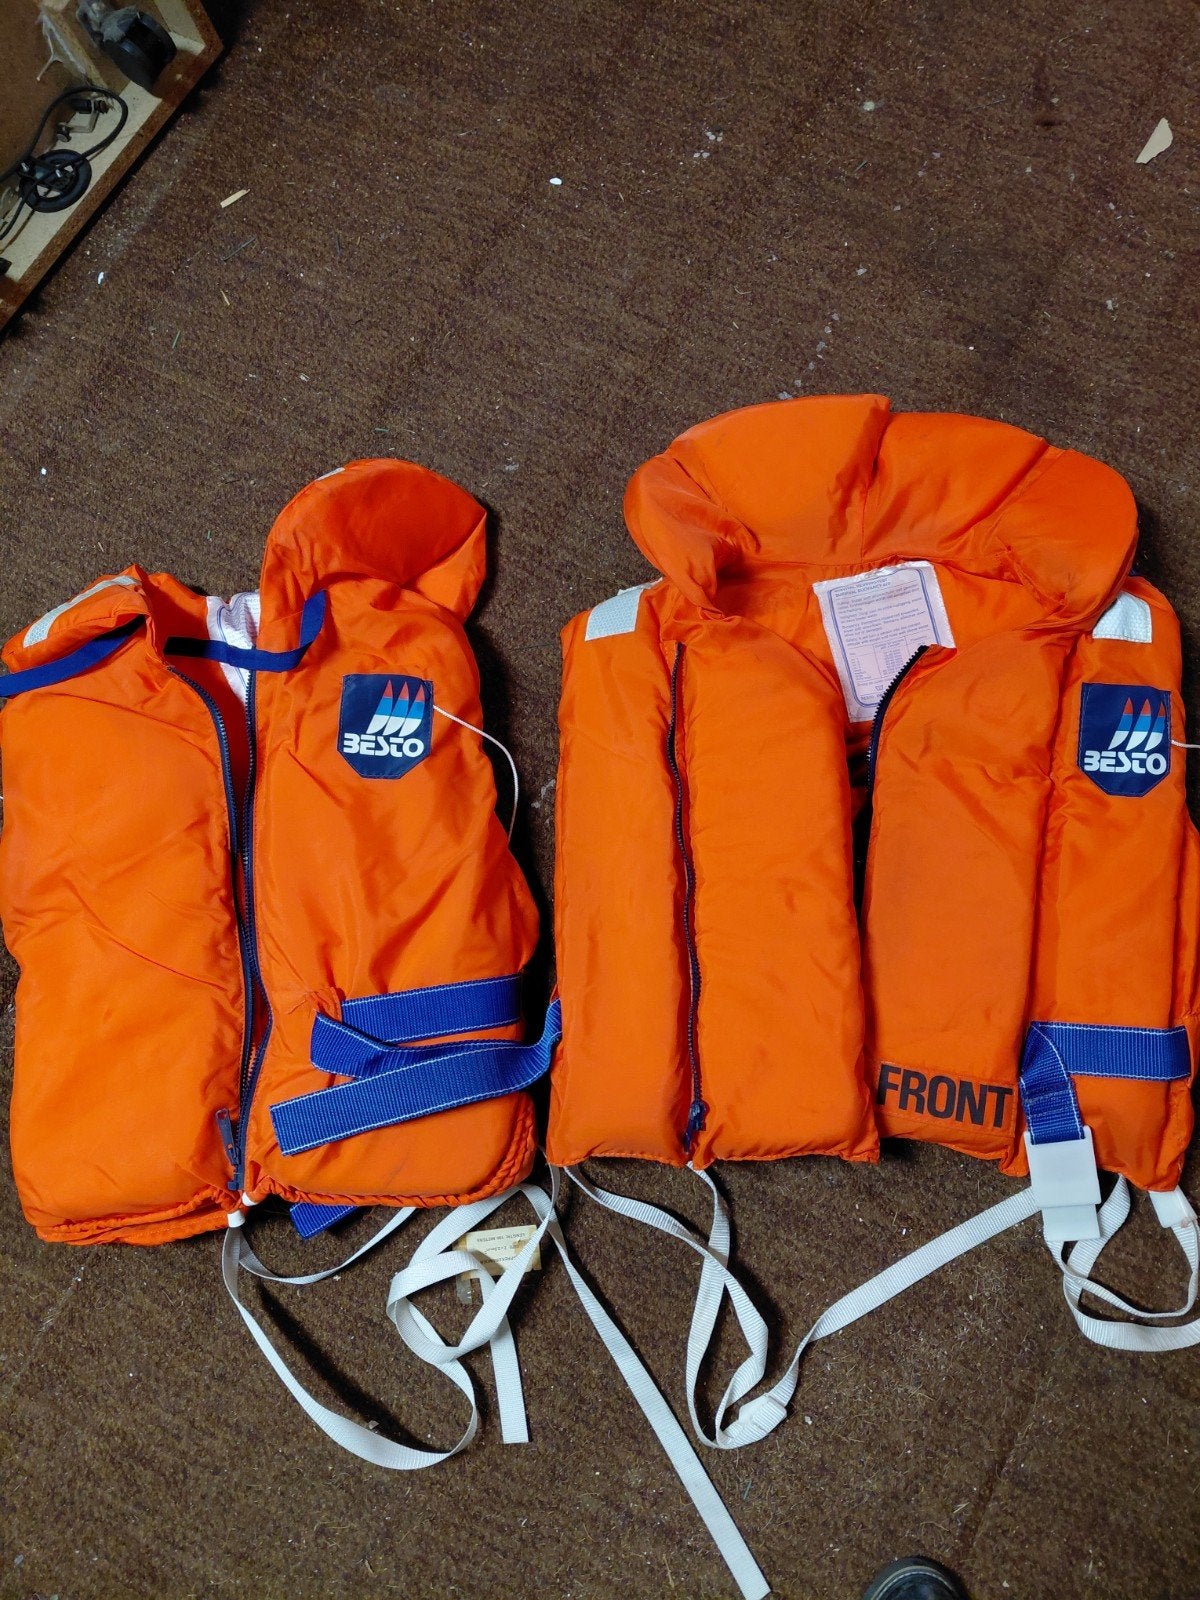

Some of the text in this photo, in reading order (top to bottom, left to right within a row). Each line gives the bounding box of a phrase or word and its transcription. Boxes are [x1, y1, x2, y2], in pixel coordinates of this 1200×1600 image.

[343, 732, 425, 758] BESTO
[1083, 750, 1167, 776] BESTO
[875, 1063, 1013, 1128] FRONT
